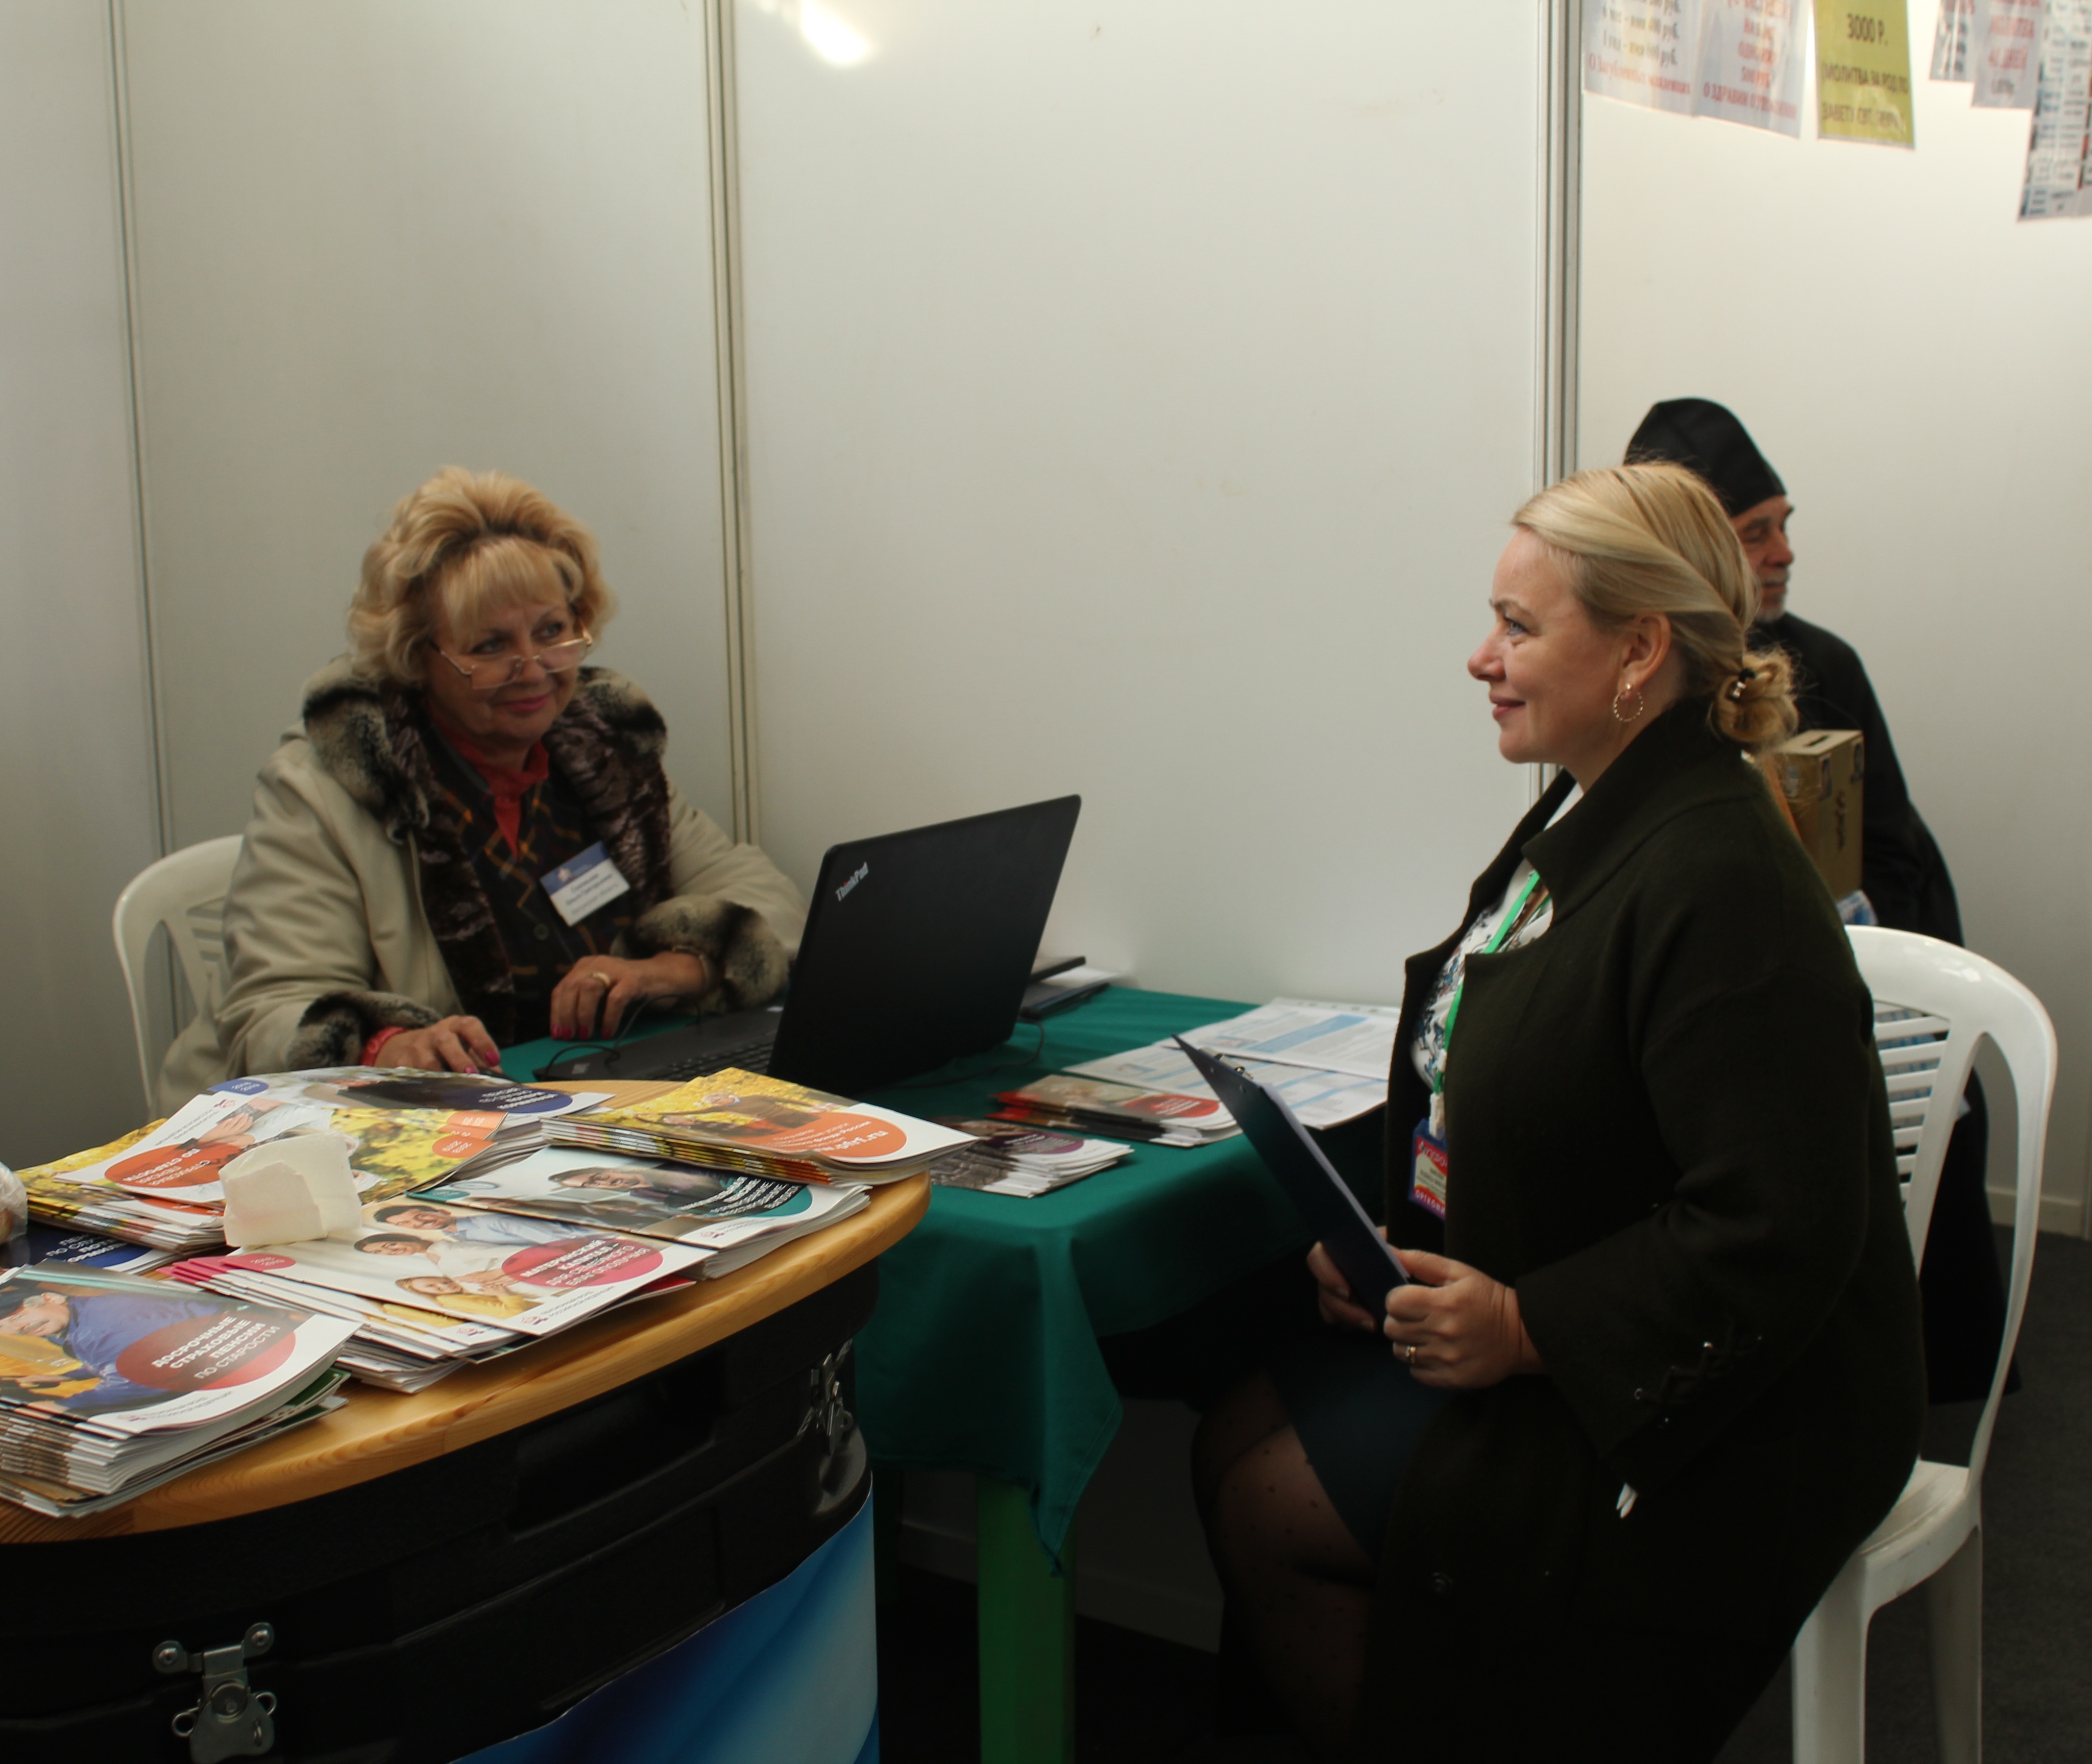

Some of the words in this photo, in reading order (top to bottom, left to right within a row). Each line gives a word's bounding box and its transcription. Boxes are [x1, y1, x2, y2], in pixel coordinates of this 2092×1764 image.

[1846, 13, 1876, 43] 3000
[835, 862, 868, 901] ThinkPad
[151, 1315, 237, 1368] ДОСРОЧНЫЕ
[169, 1319, 252, 1369] СТРАХОВЫЕ
[193, 1366, 218, 1379] ПО
[215, 1325, 281, 1368] СТАРОСТИ
[208, 1321, 267, 1359] ПЕНСИИ
